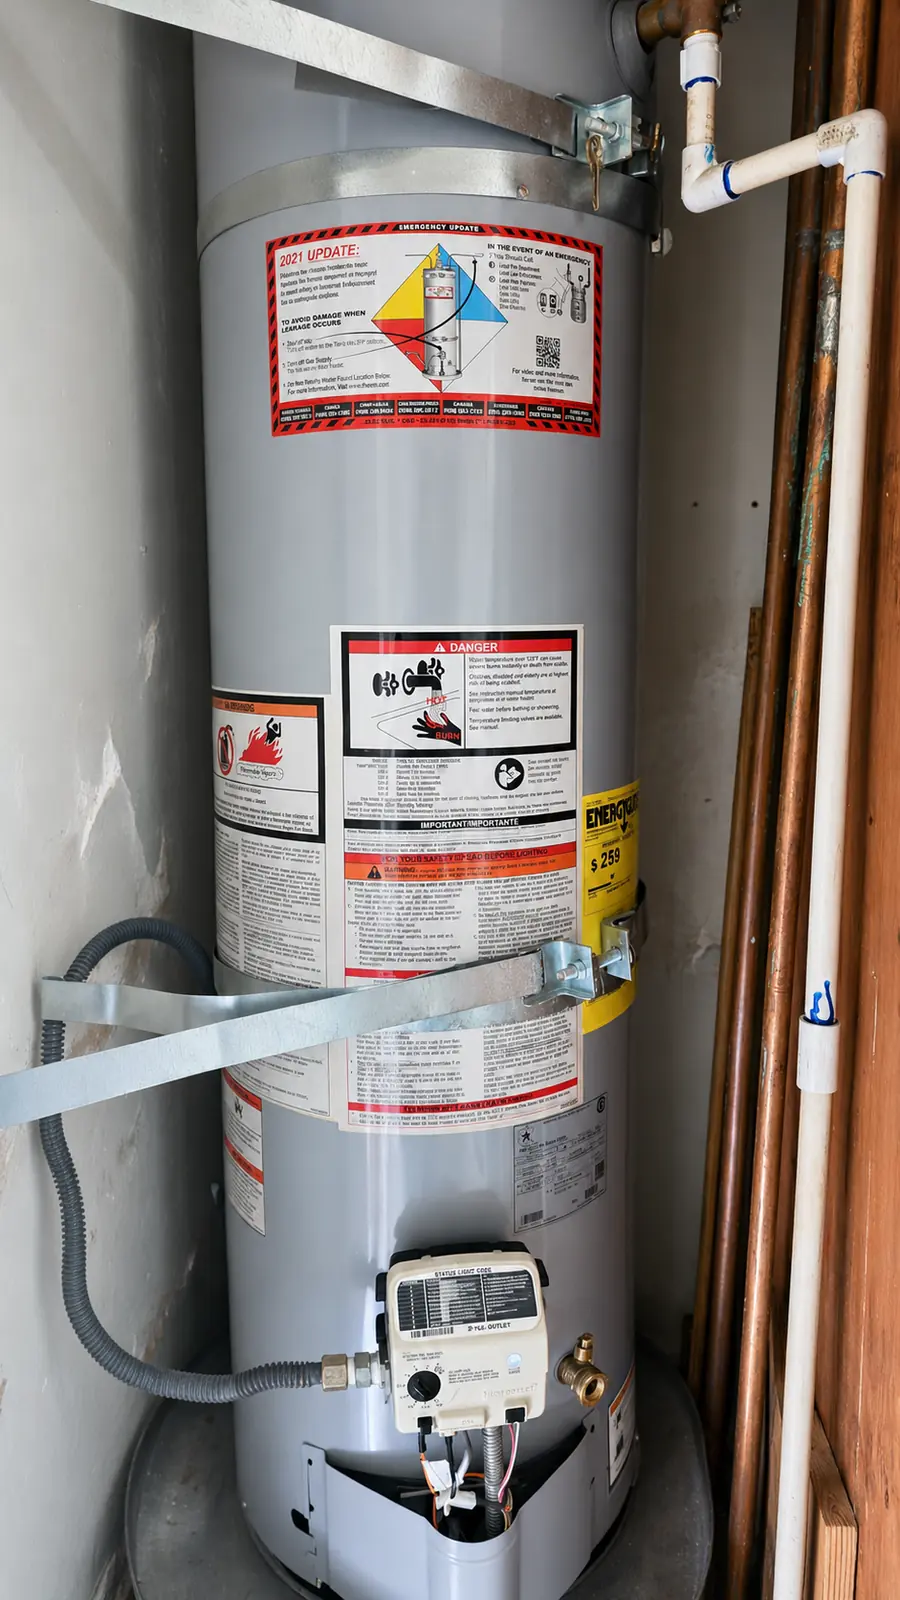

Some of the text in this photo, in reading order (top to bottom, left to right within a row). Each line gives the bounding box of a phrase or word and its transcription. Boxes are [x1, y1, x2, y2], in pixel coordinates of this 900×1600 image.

[399, 223, 479, 232] EMERGENCY UPDATE
[512, 245, 533, 254] EVENT
[279, 244, 360, 267] 2021 UPDATE:
[291, 316, 311, 324] AVOID
[312, 311, 342, 321] DAMAGE
[343, 310, 366, 318] WHEN
[312, 320, 342, 329] OCCURS
[450, 642, 498, 653] DANGER
[426, 695, 448, 705] HOT
[435, 731, 460, 741] BURN
[600, 847, 620, 869] 259
[487, 1322, 511, 1330] OUTLET
